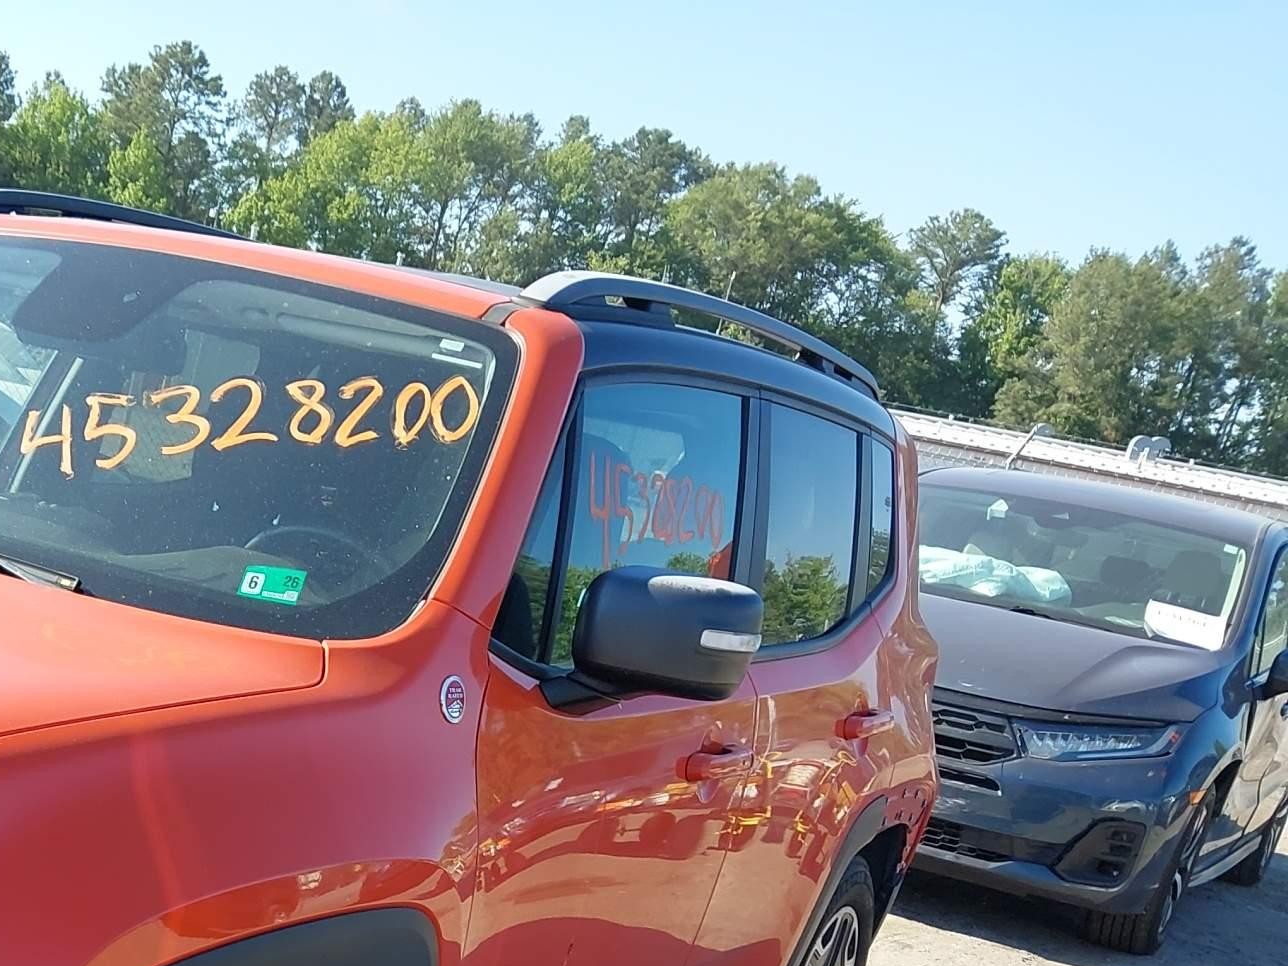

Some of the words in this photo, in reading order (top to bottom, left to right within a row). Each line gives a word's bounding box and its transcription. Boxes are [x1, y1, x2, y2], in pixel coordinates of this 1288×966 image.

[20, 373, 481, 481] 45328200
[589, 450, 726, 570] 45328200
[248, 575, 259, 590] 6
[283, 575, 300, 589] 26
